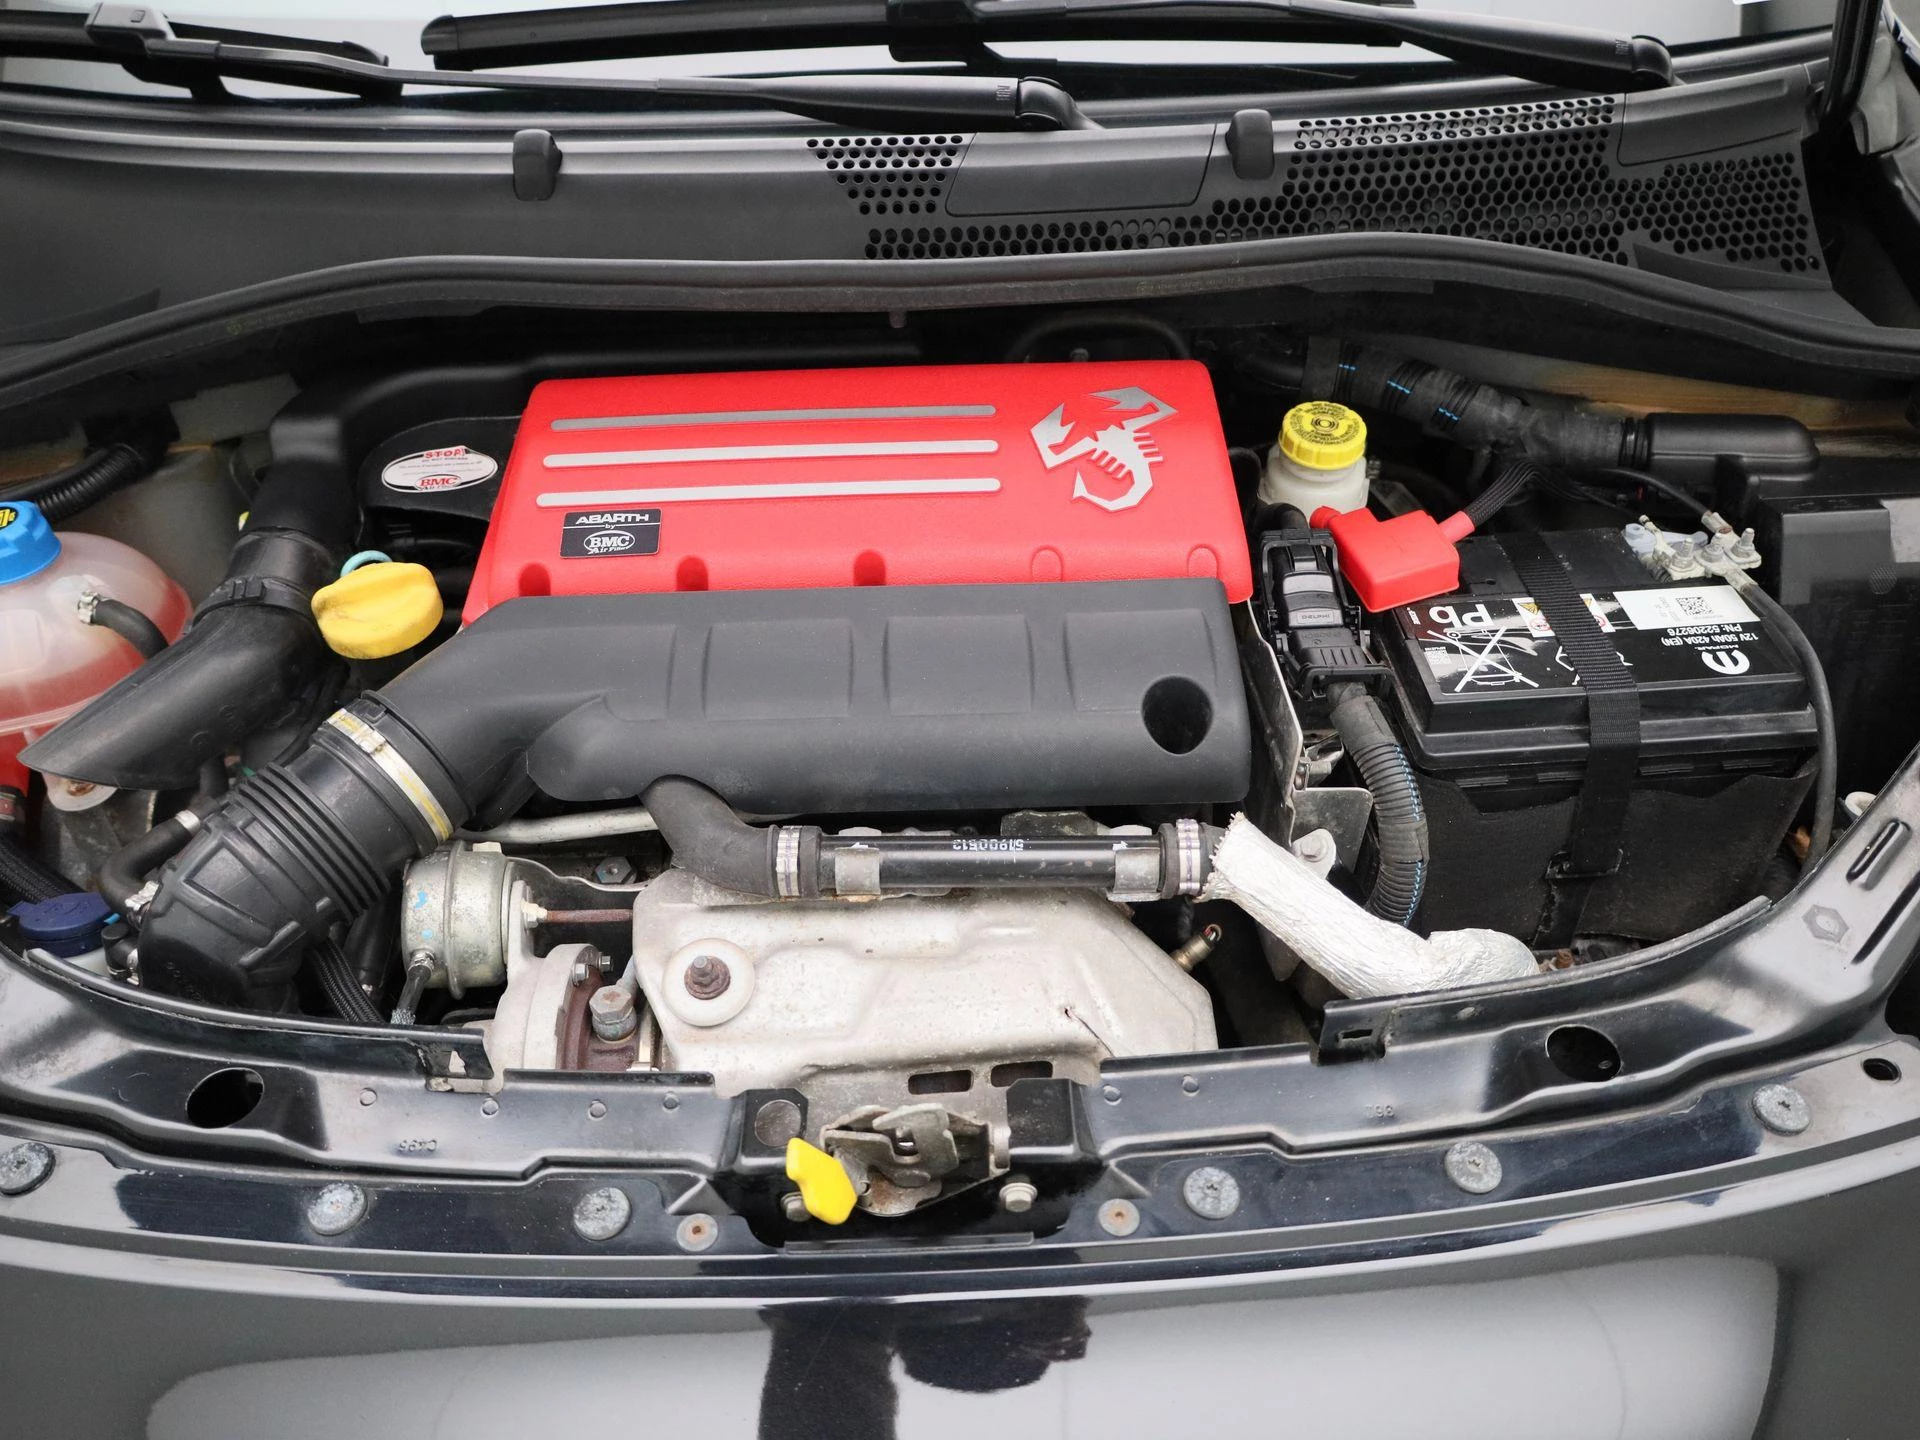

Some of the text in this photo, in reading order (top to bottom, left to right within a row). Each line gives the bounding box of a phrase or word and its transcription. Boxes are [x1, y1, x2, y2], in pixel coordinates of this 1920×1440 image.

[420, 477, 458, 487] BMC
[575, 513, 649, 525] ABARTH
[588, 535, 630, 548] BMC
[587, 546, 608, 555] Air
[1429, 604, 1494, 628] Pb
[1720, 623, 1743, 633] PN:
[1660, 632, 1759, 647] 12V 50Ah 420A (EN)
